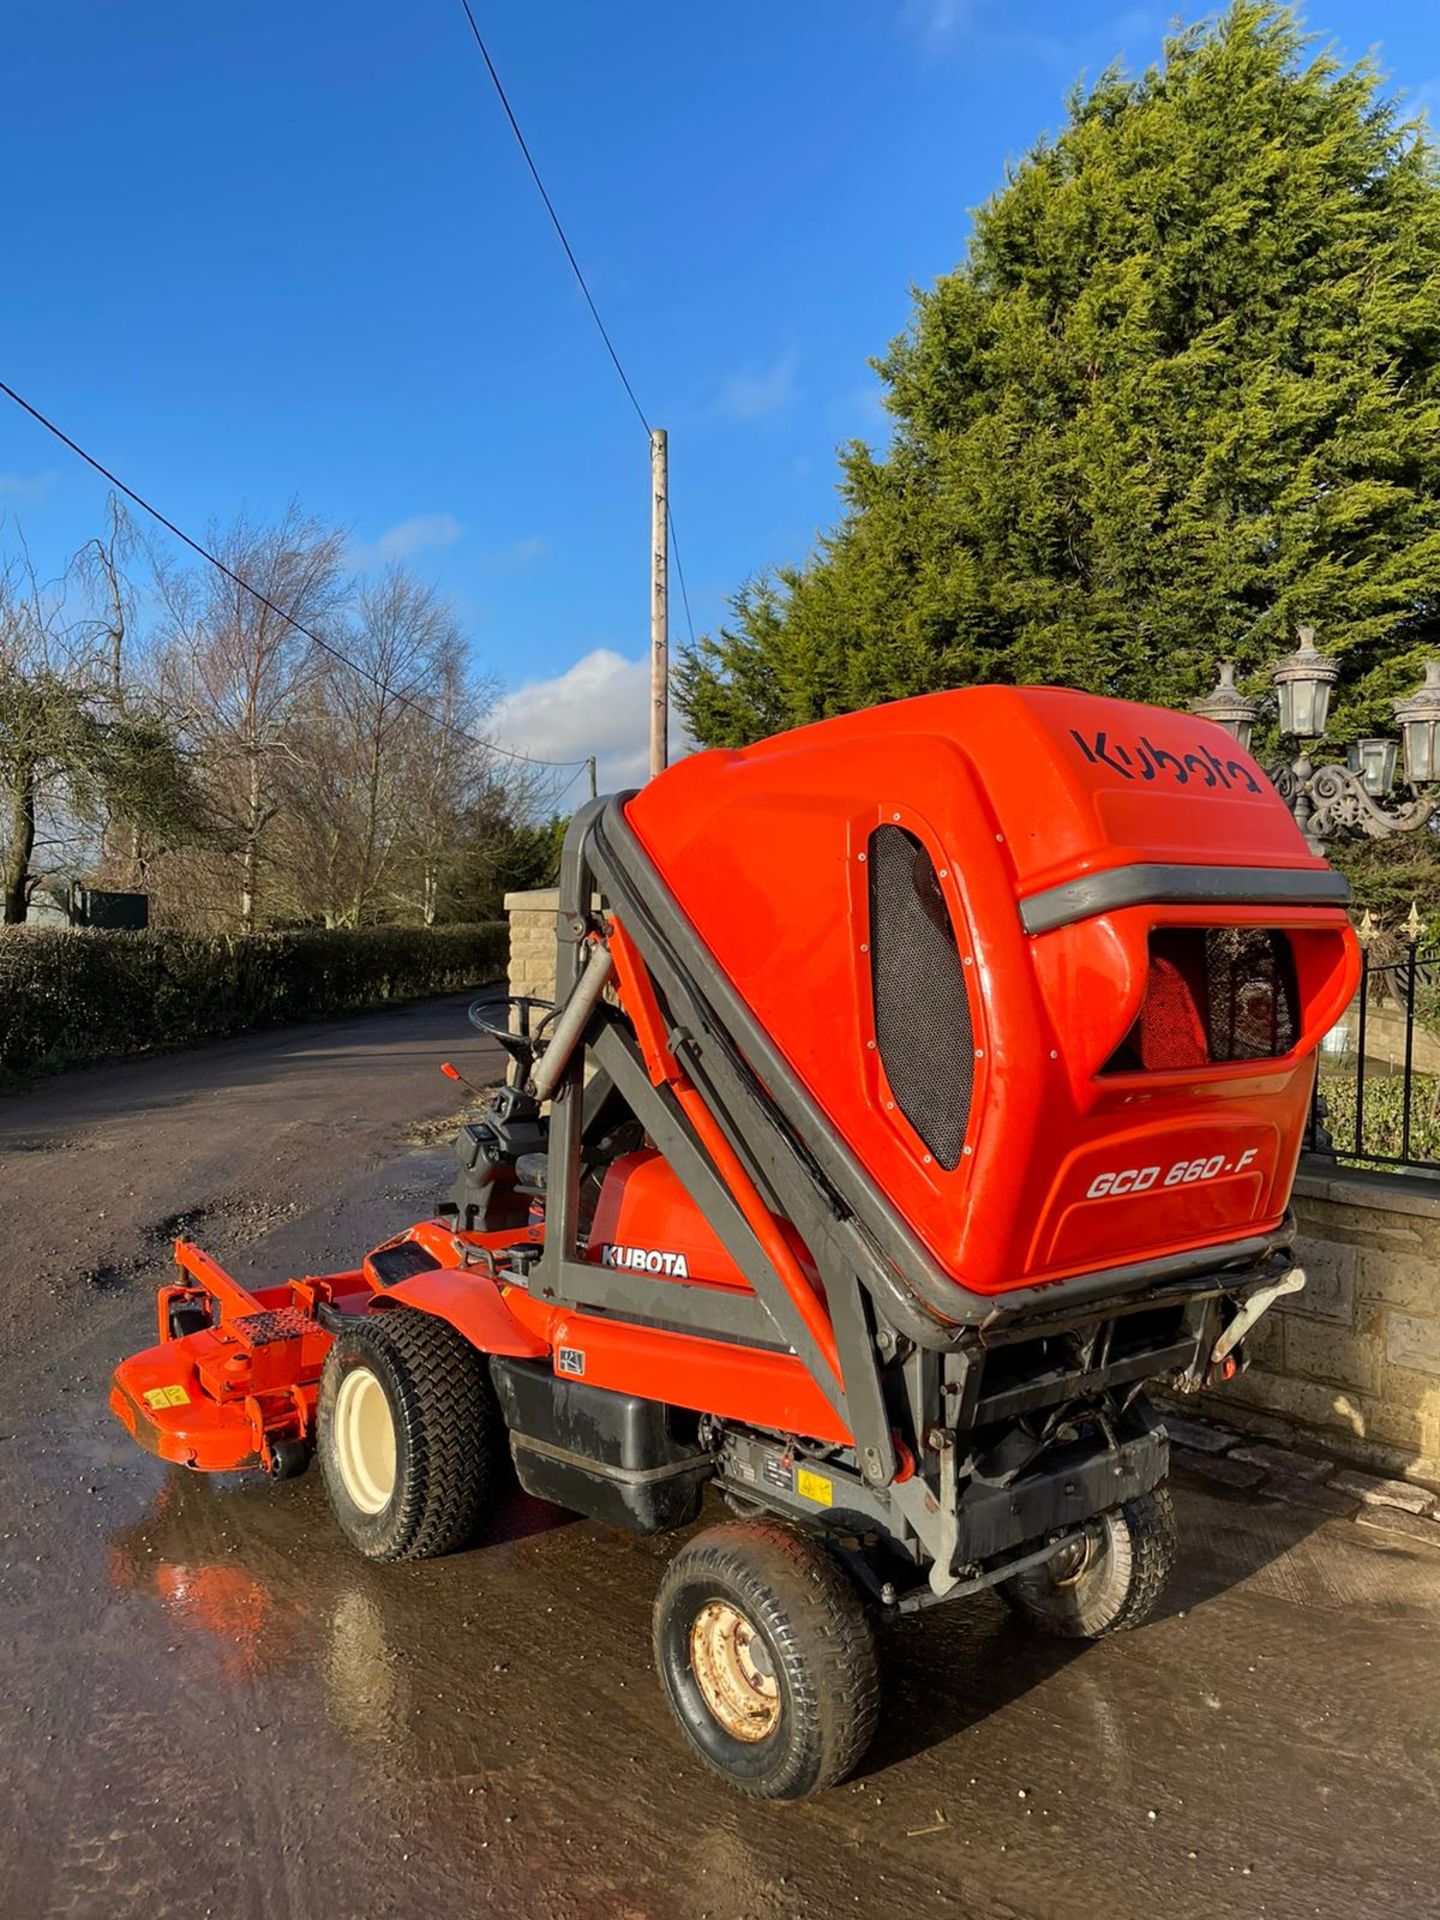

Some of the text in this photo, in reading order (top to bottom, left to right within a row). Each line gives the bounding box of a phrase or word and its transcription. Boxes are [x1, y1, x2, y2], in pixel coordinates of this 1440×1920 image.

[1070, 729, 1262, 793] Kubota
[1086, 1166, 1161, 1199] GCD
[601, 1244, 688, 1279] KUBOTA
